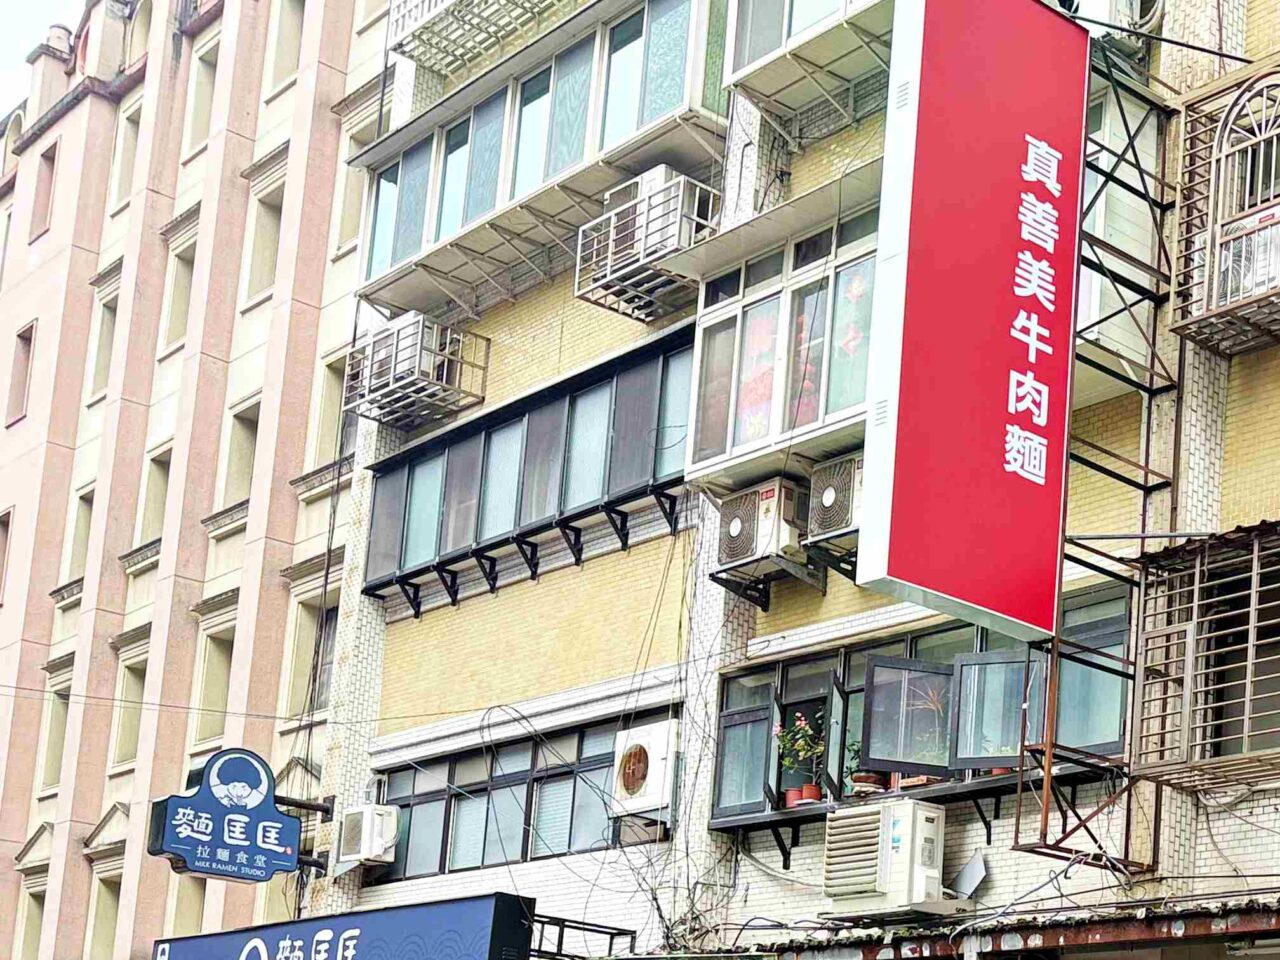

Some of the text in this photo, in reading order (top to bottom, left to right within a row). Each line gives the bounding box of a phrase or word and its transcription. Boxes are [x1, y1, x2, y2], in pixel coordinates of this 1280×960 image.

[1003, 133, 1064, 486] 真善美牛肉麵
[171, 807, 286, 854] 麵匡匡
[196, 844, 268, 868] 拉麵食堂
[211, 862, 238, 873] RAMEN
[240, 866, 266, 878] STUDIO
